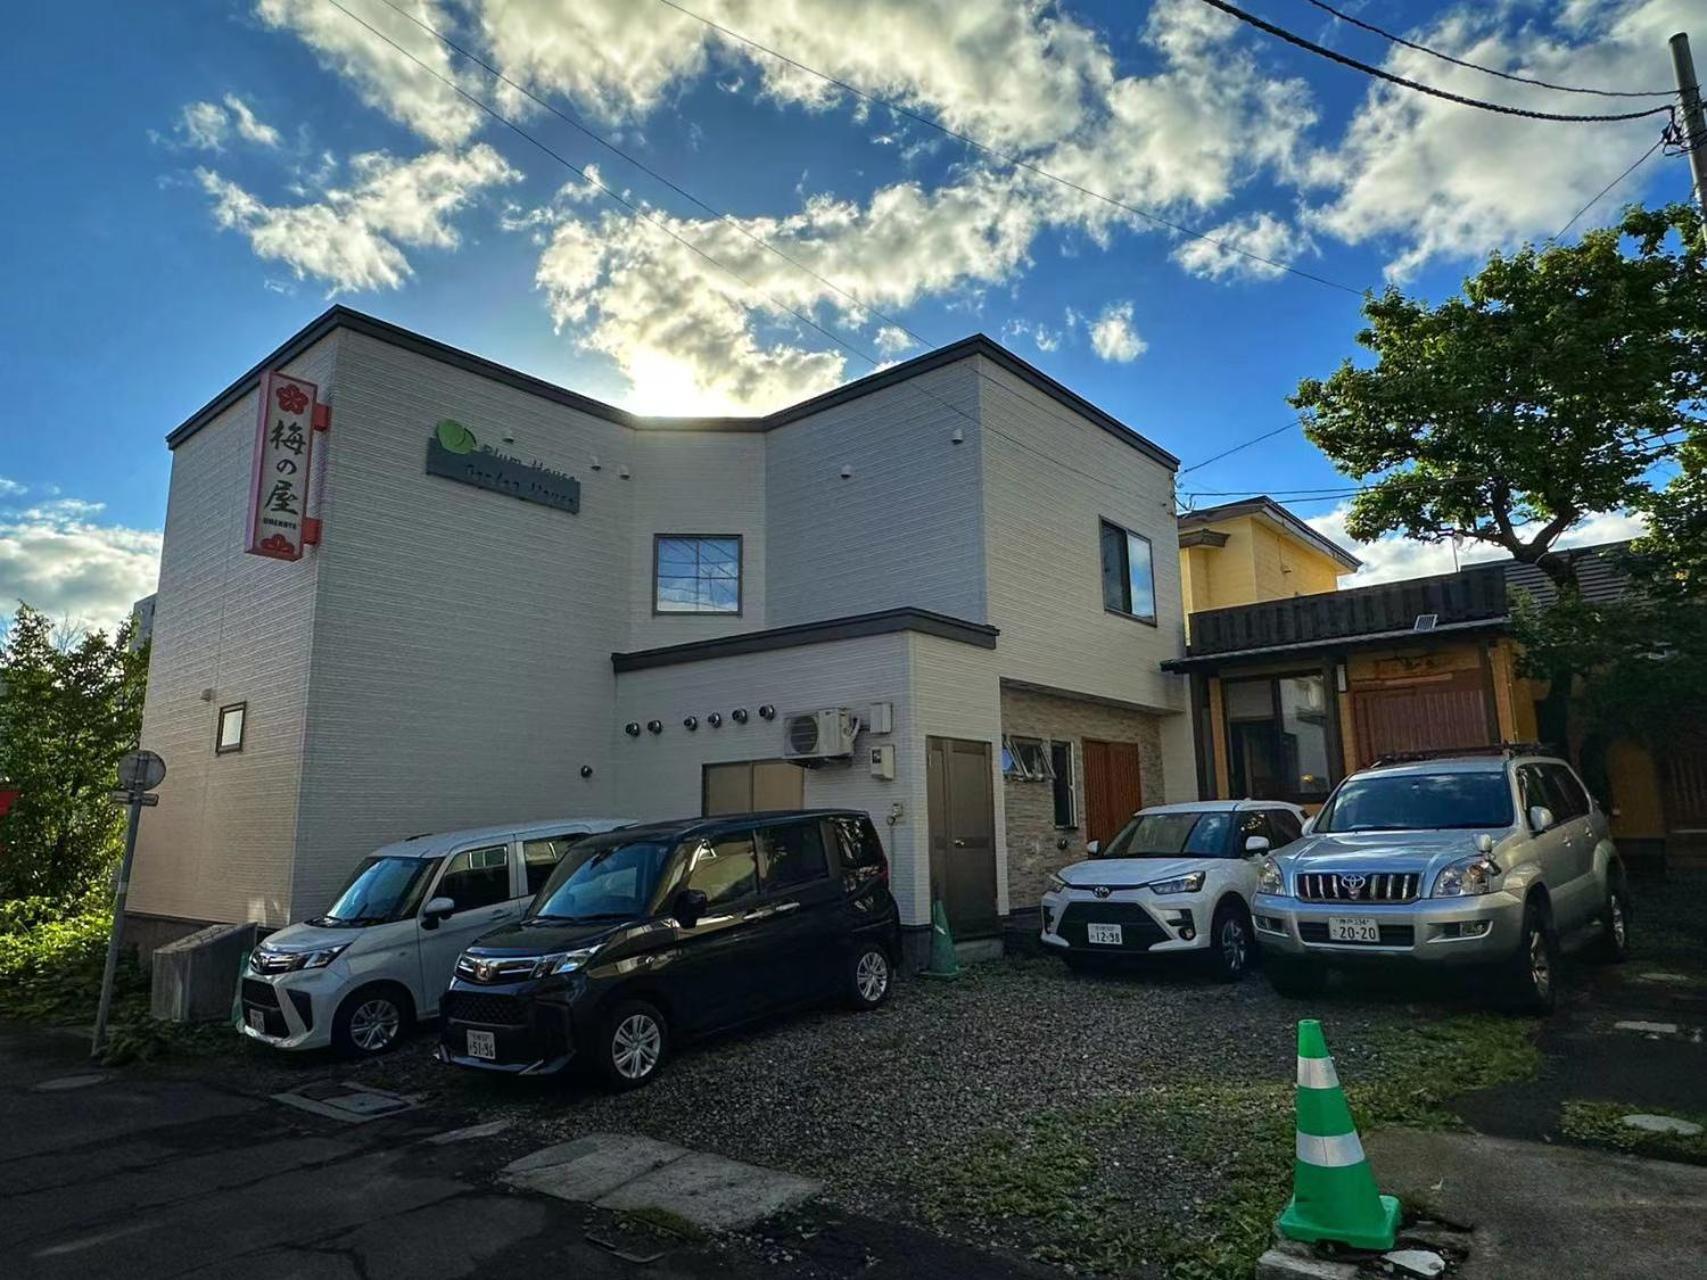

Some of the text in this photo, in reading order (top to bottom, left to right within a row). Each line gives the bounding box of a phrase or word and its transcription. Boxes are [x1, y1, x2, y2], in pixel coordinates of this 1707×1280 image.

[264, 420, 306, 515] 梅の屋
[1340, 926, 1376, 940] 20-20
